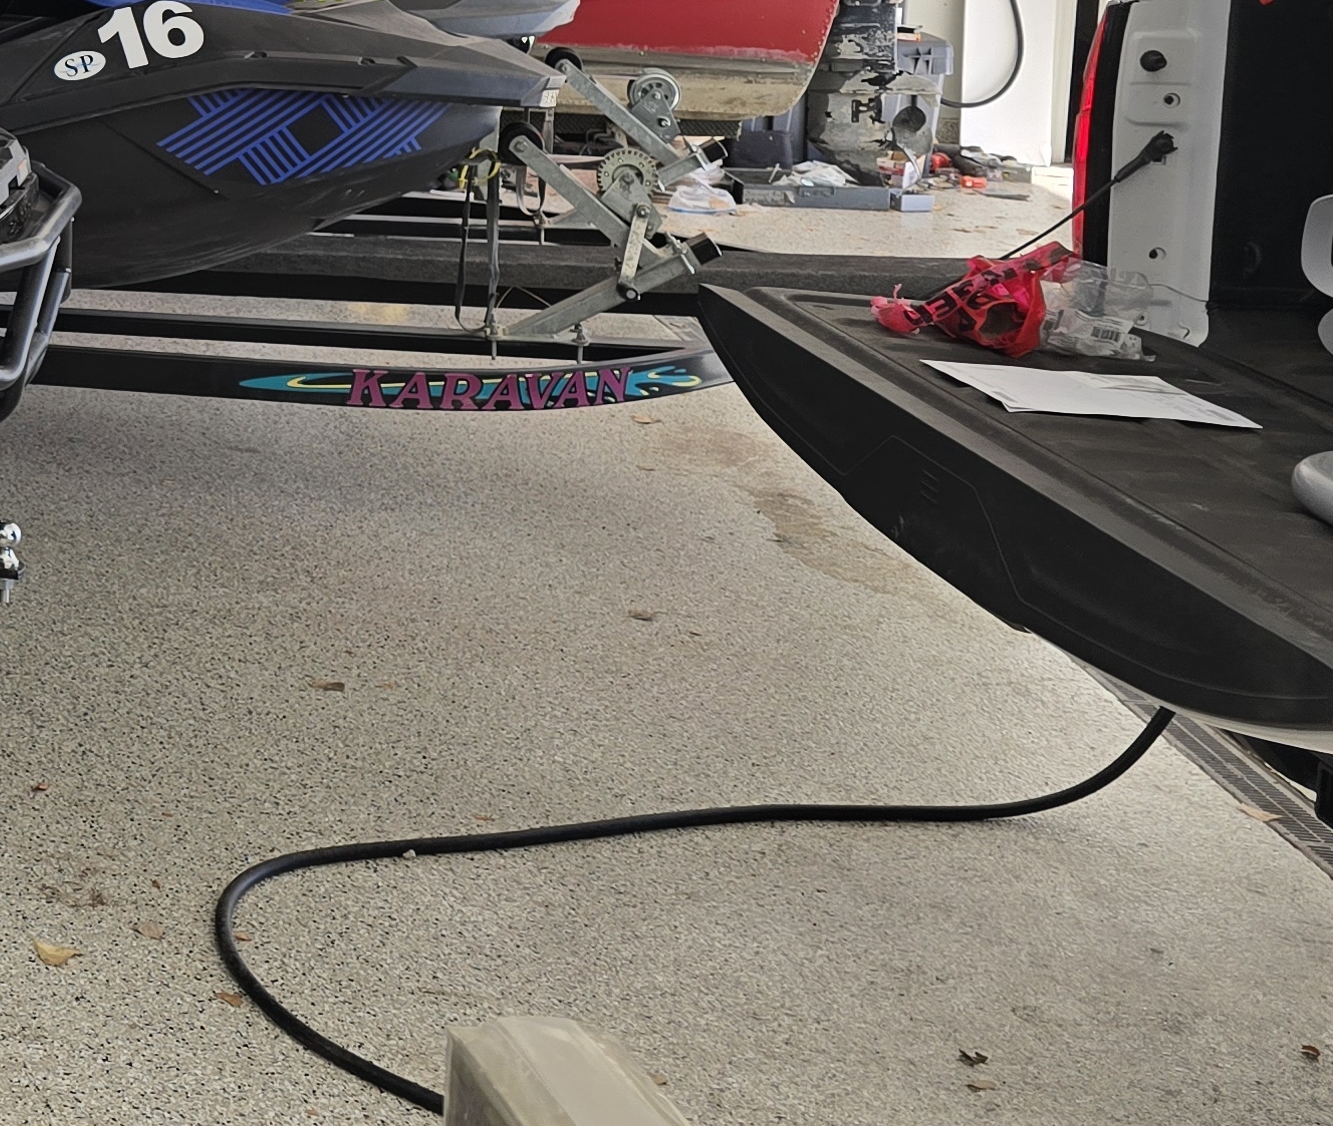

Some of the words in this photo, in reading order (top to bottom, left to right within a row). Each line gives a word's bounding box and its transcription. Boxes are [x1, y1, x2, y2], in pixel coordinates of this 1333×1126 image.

[97, 0, 205, 69] 16
[64, 54, 94, 78] SP
[346, 366, 631, 411] KARAVAN
